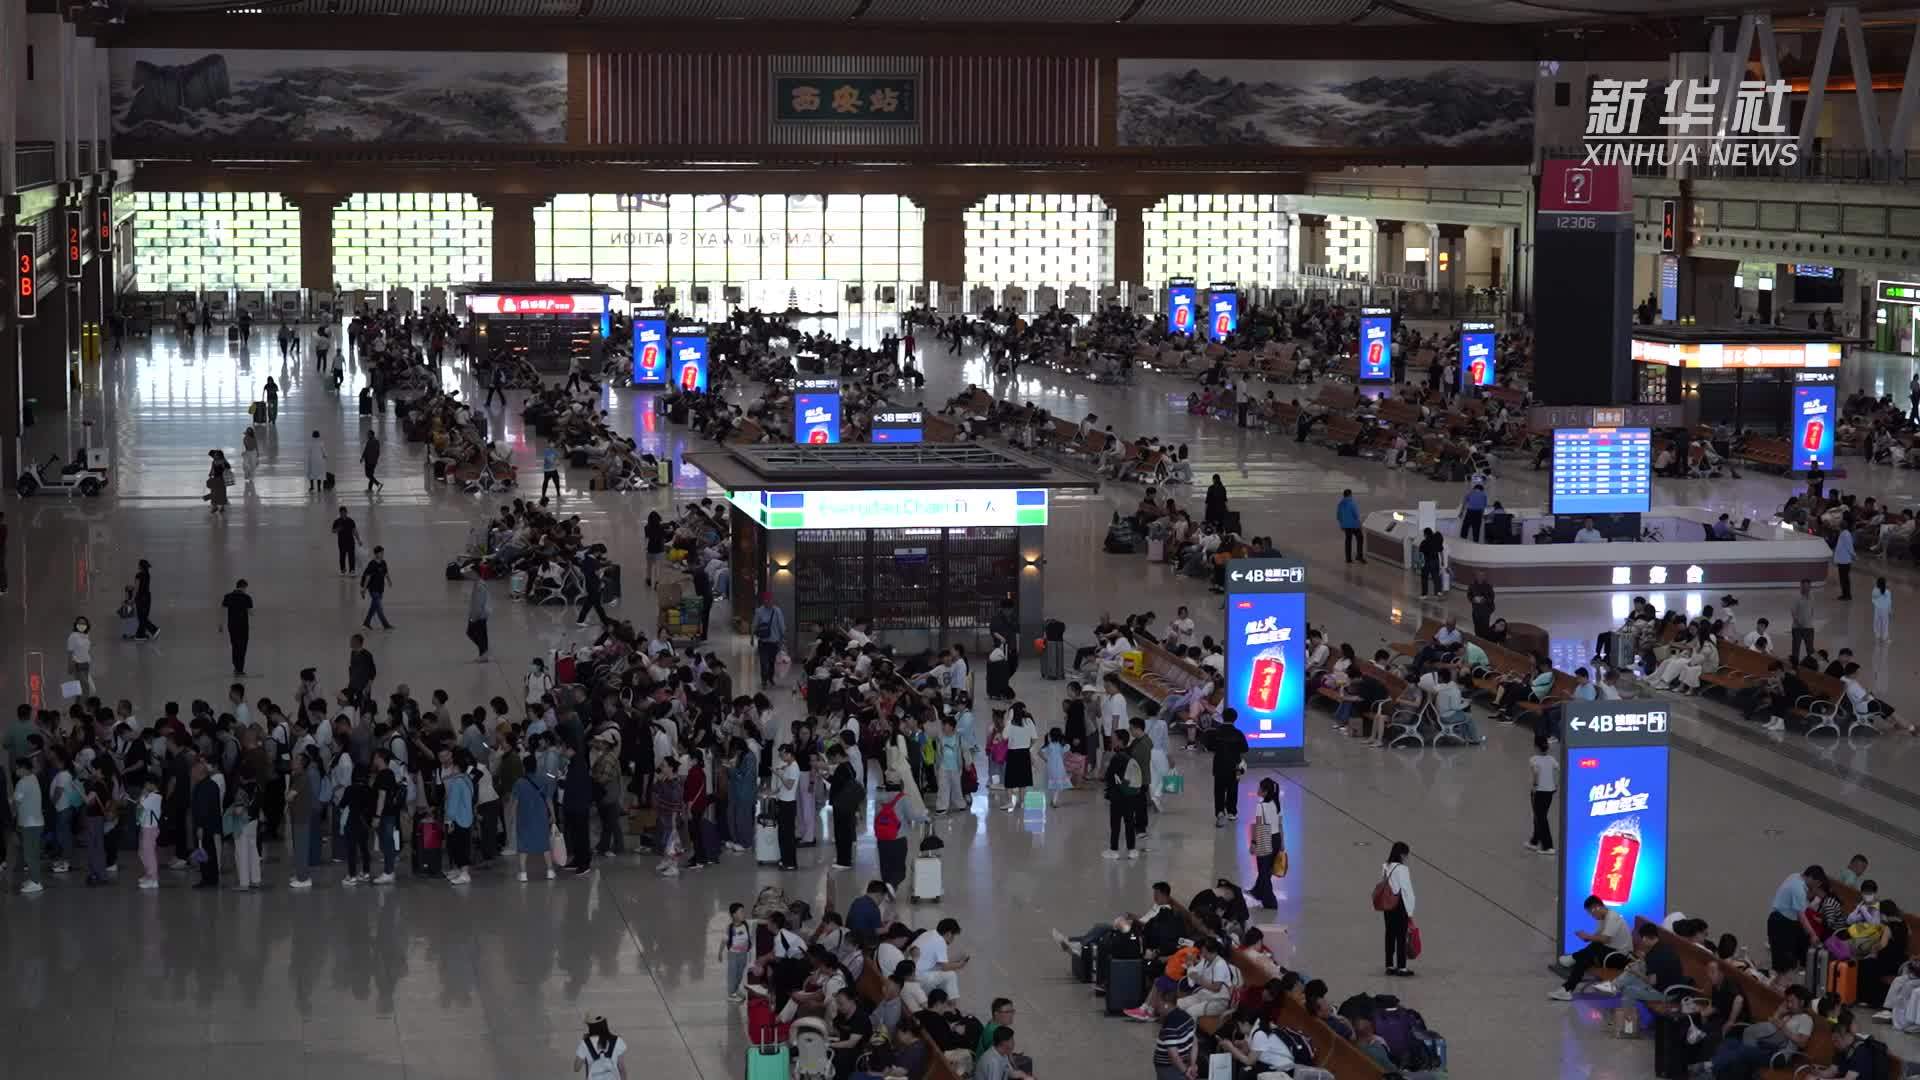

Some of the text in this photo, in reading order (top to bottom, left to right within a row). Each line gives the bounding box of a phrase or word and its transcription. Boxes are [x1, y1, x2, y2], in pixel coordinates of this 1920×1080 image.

[791, 85, 899, 113] 西安站
[1556, 216, 1597, 229] 12306
[21, 255, 32, 296] 3B
[1245, 569, 1265, 583] 4B
[1588, 715, 1613, 733] 4B
